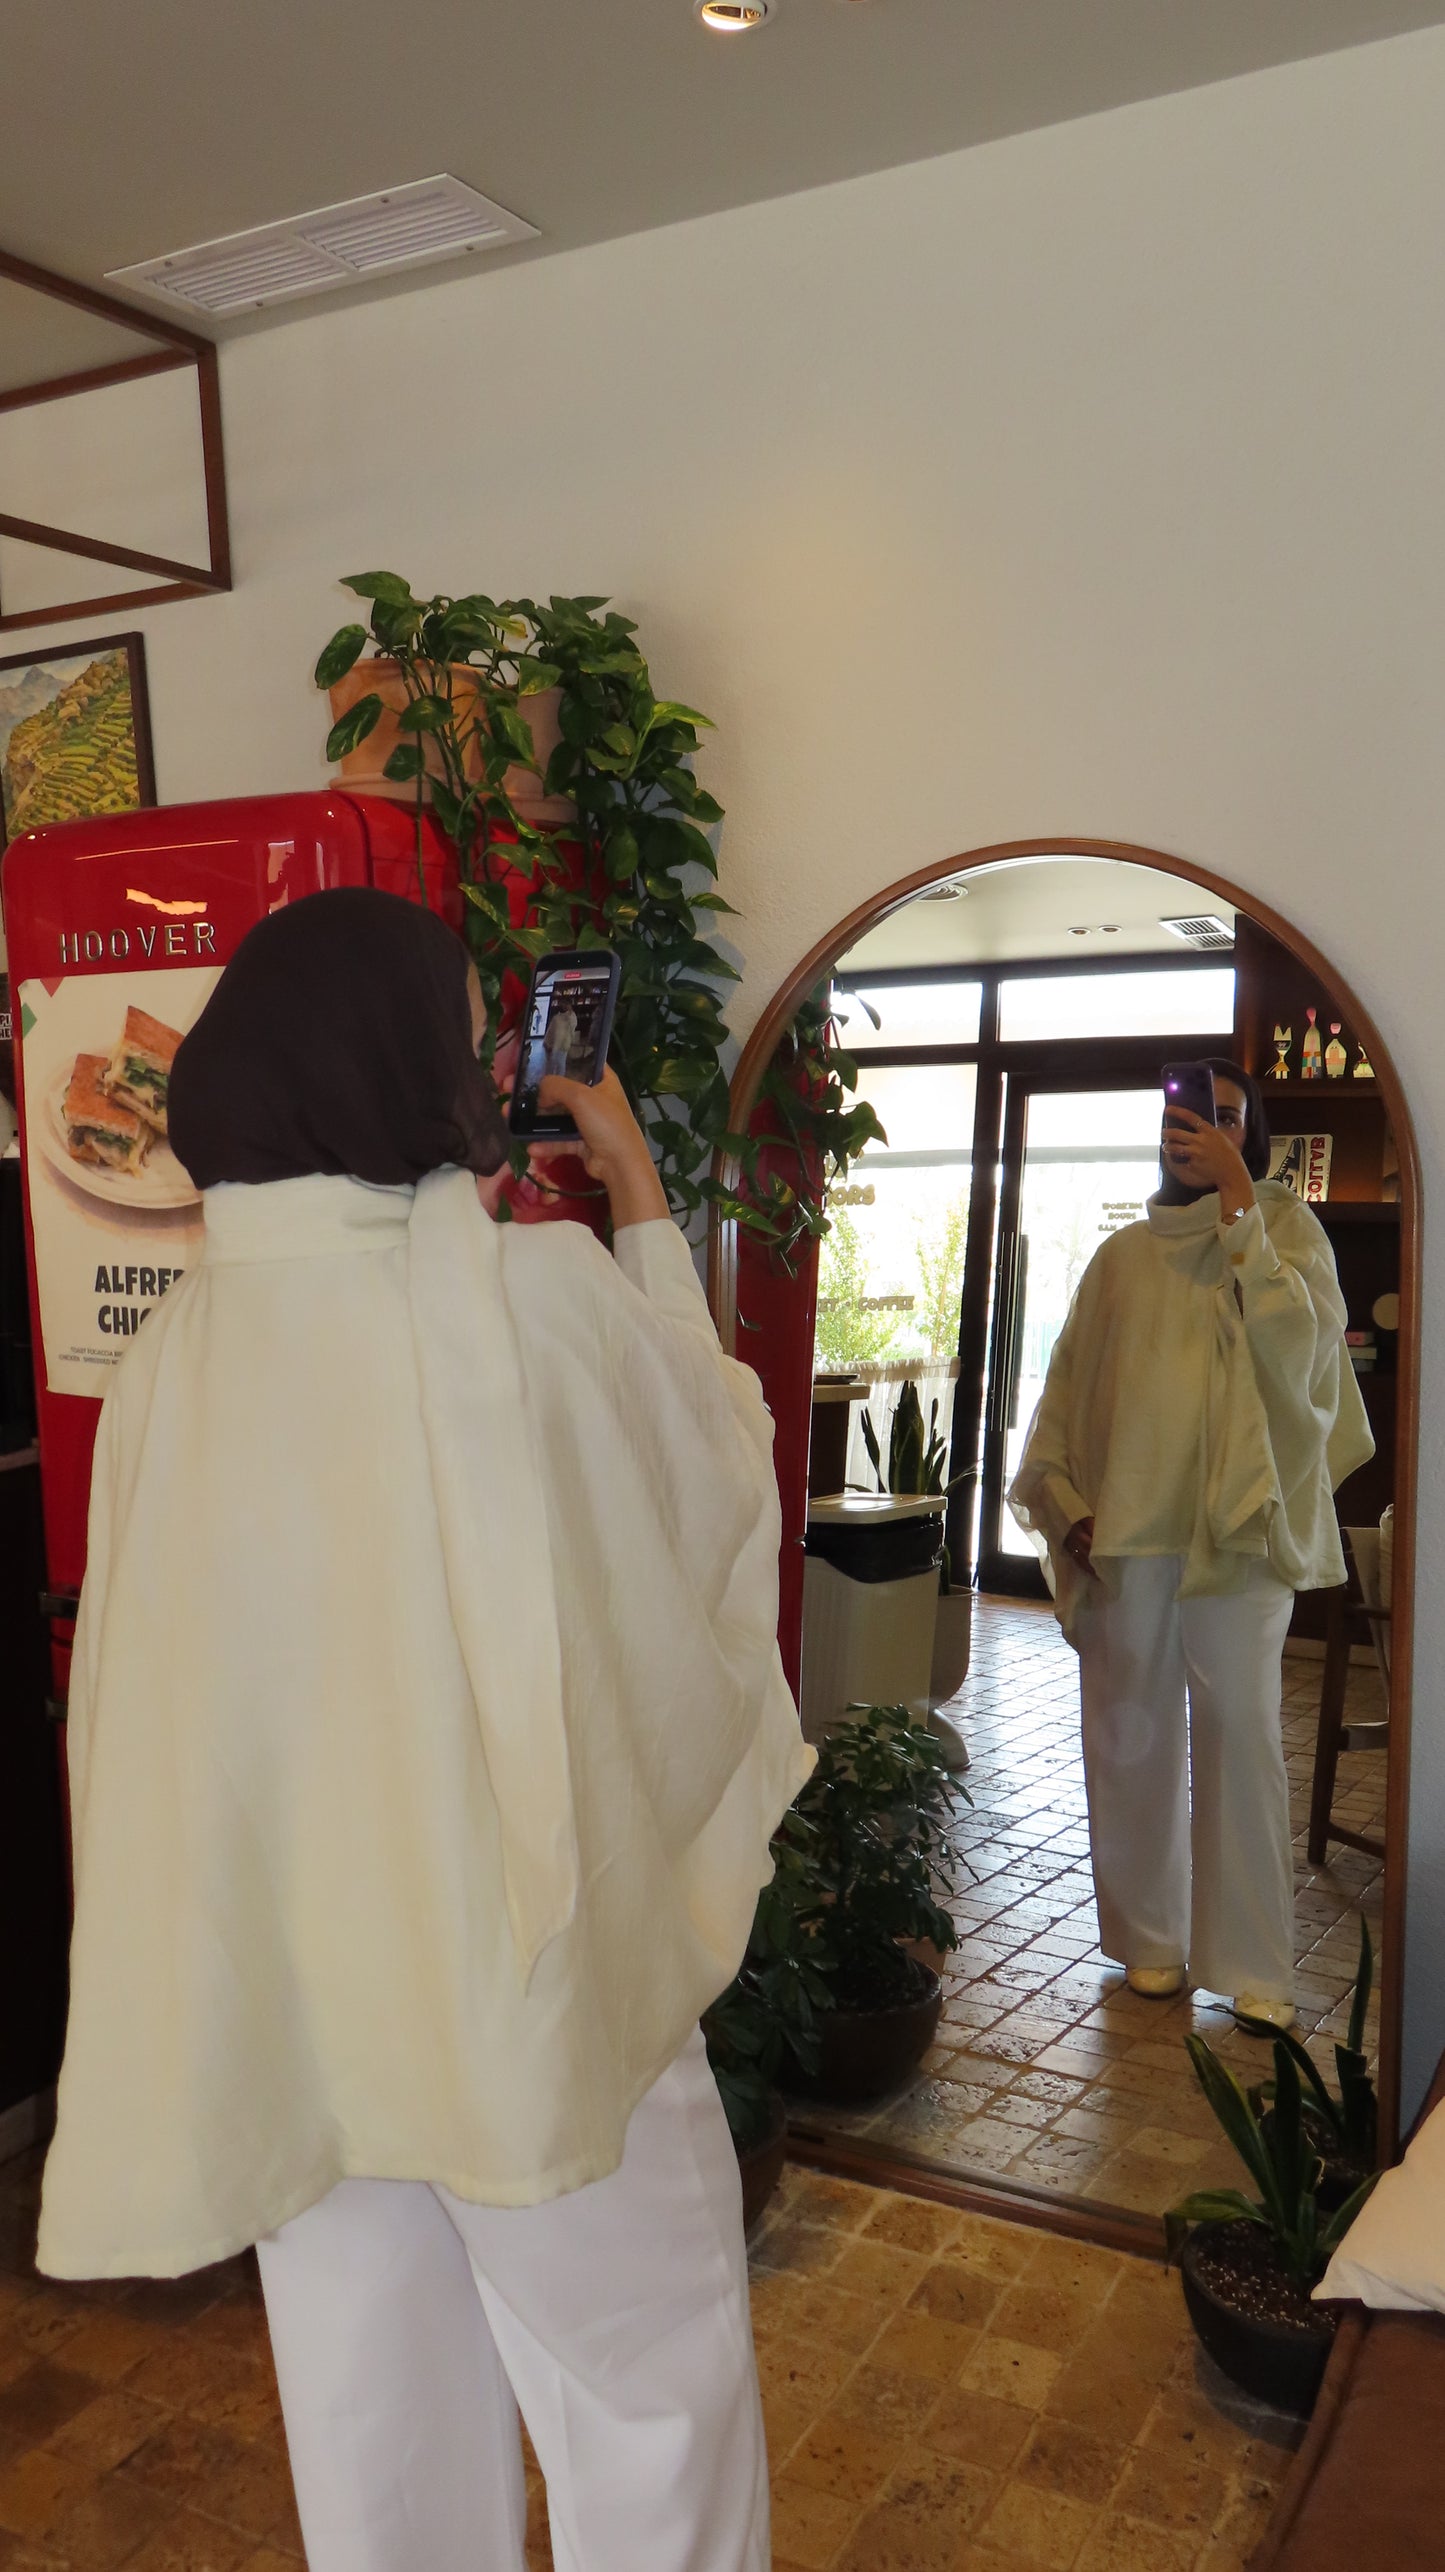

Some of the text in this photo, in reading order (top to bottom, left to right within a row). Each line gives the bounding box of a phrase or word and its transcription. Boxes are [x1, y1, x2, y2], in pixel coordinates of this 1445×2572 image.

[59, 922, 216, 963] HOOVER
[1108, 1212, 1136, 1220] HOURS
[859, 1296, 915, 1311] COFFEE
